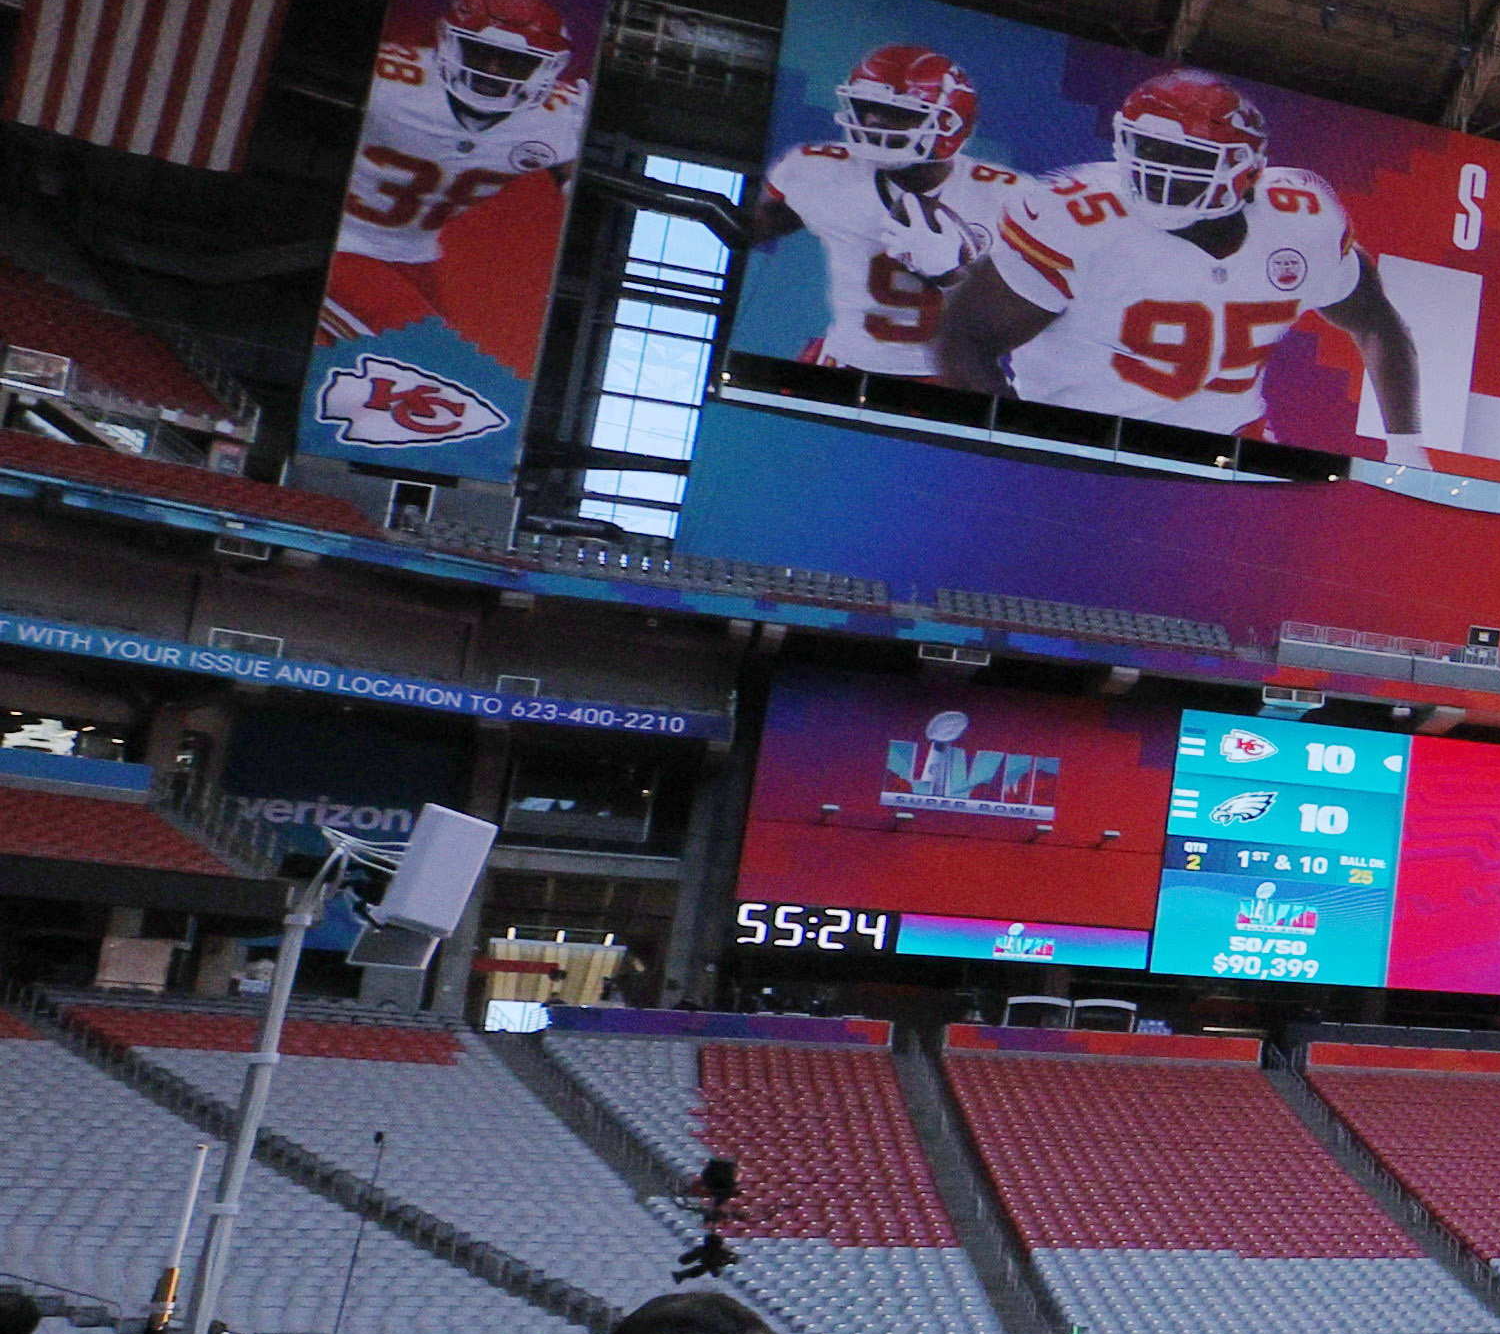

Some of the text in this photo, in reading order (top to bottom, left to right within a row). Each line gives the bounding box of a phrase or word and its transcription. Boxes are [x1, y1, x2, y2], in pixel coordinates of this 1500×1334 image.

[1110, 298, 1302, 402] 95
[17, 625, 93, 652] WITH
[100, 636, 182, 666] YOUR
[190, 650, 272, 679] ISSUE
[275, 665, 331, 688] AND
[337, 671, 463, 708] LOCATION
[471, 694, 502, 714] TO
[511, 700, 686, 734] 623-400-2210
[1305, 742, 1357, 774] 10
[238, 795, 413, 833] verizon
[1298, 803, 1350, 835] 10
[1183, 841, 1209, 855] QTR
[1184, 854, 1202, 871] 2
[1237, 849, 1329, 875] 1ST & 10
[1348, 868, 1375, 885] 25
[736, 902, 888, 951] 55:24
[1228, 935, 1308, 957] 50/50
[1211, 952, 1320, 980] $90,399
